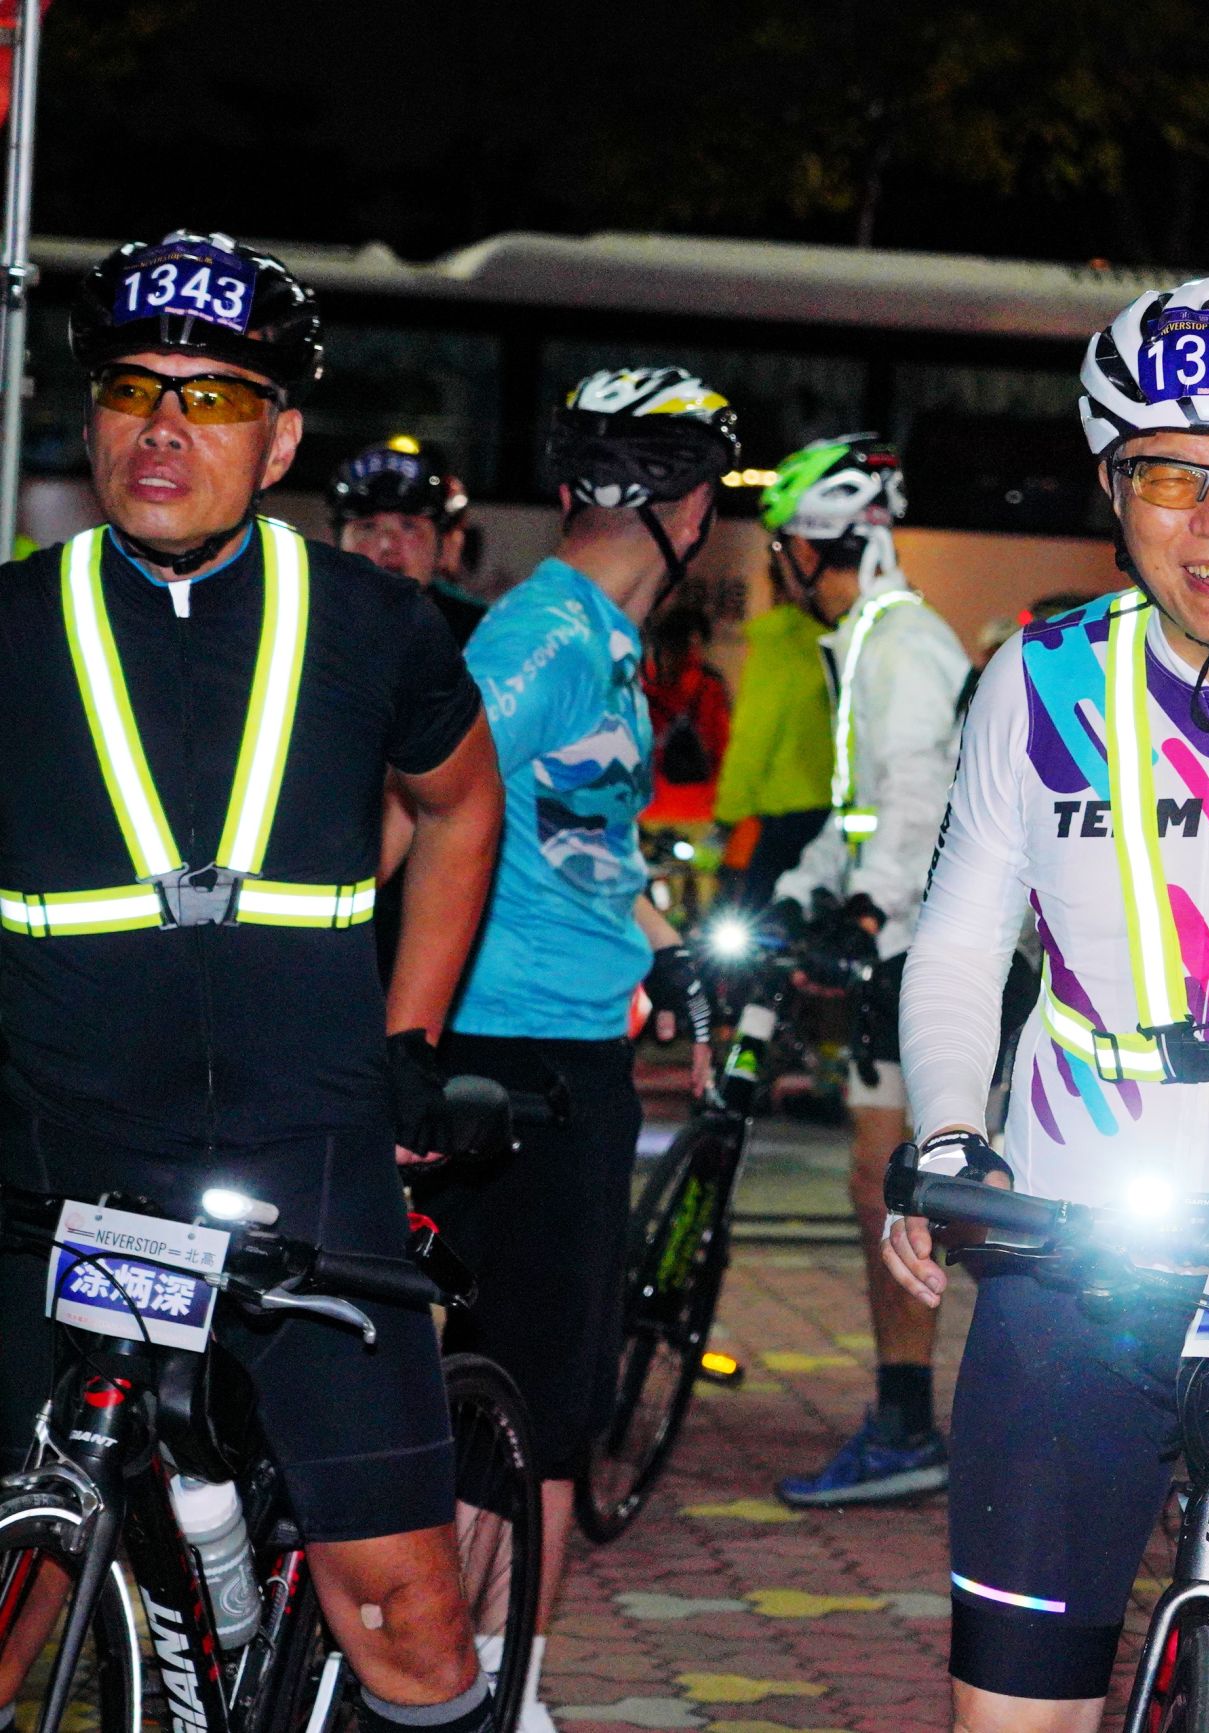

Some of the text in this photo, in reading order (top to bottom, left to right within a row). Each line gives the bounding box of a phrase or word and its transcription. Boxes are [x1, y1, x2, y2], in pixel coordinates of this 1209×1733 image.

[125, 263, 246, 319] 1343
[1053, 798, 1203, 839] TEM
[96, 1229, 217, 1267] NEVERSTOP 北高
